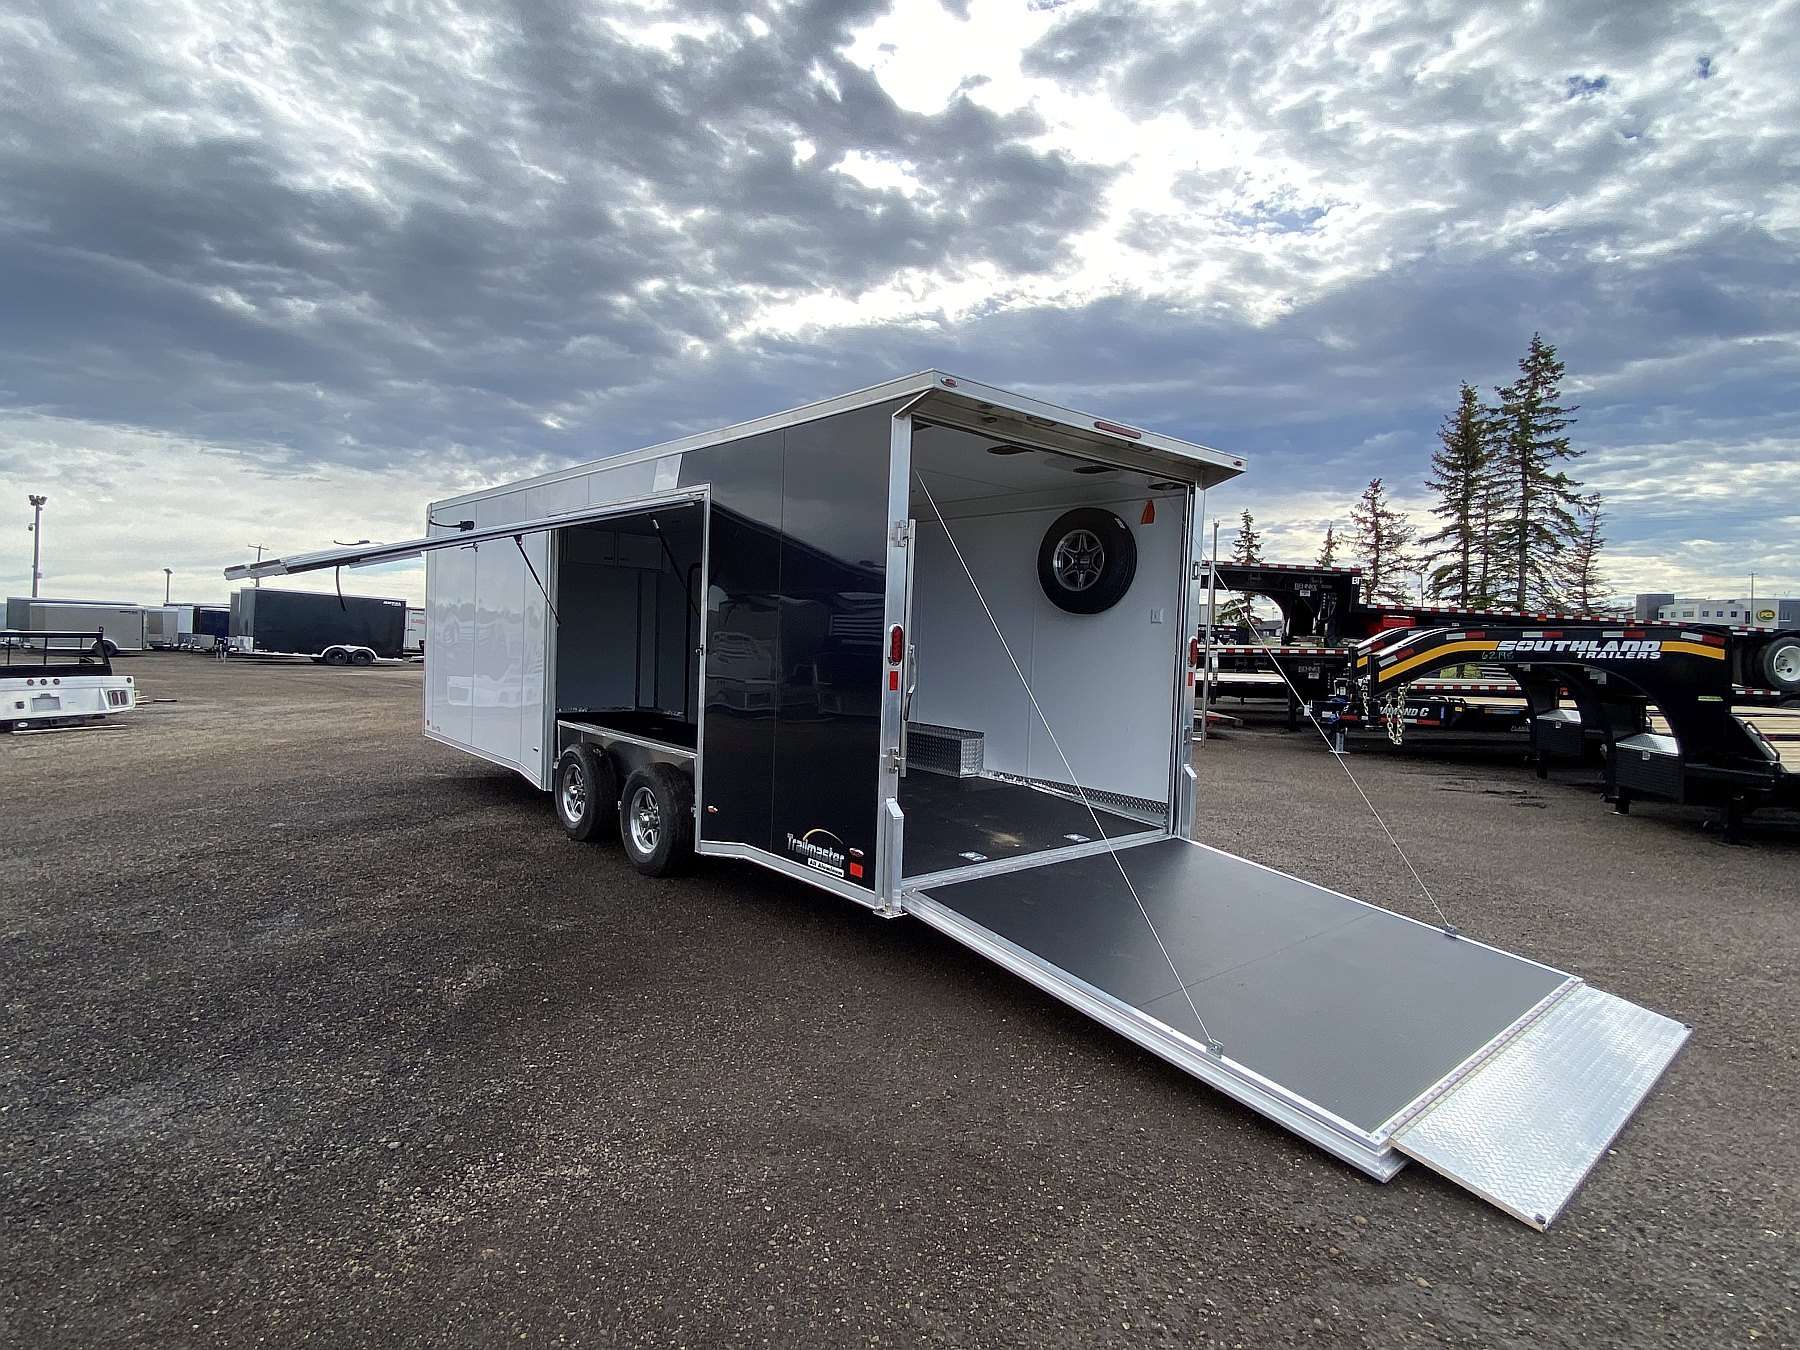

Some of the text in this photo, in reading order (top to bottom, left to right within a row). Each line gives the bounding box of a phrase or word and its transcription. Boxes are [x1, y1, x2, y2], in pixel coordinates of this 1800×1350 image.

[1497, 640, 1662, 651] SOUTHLAND
[1576, 651, 1661, 660] TRAILERS
[1419, 707, 1430, 717] C
[787, 832, 845, 868] Trailmaster
